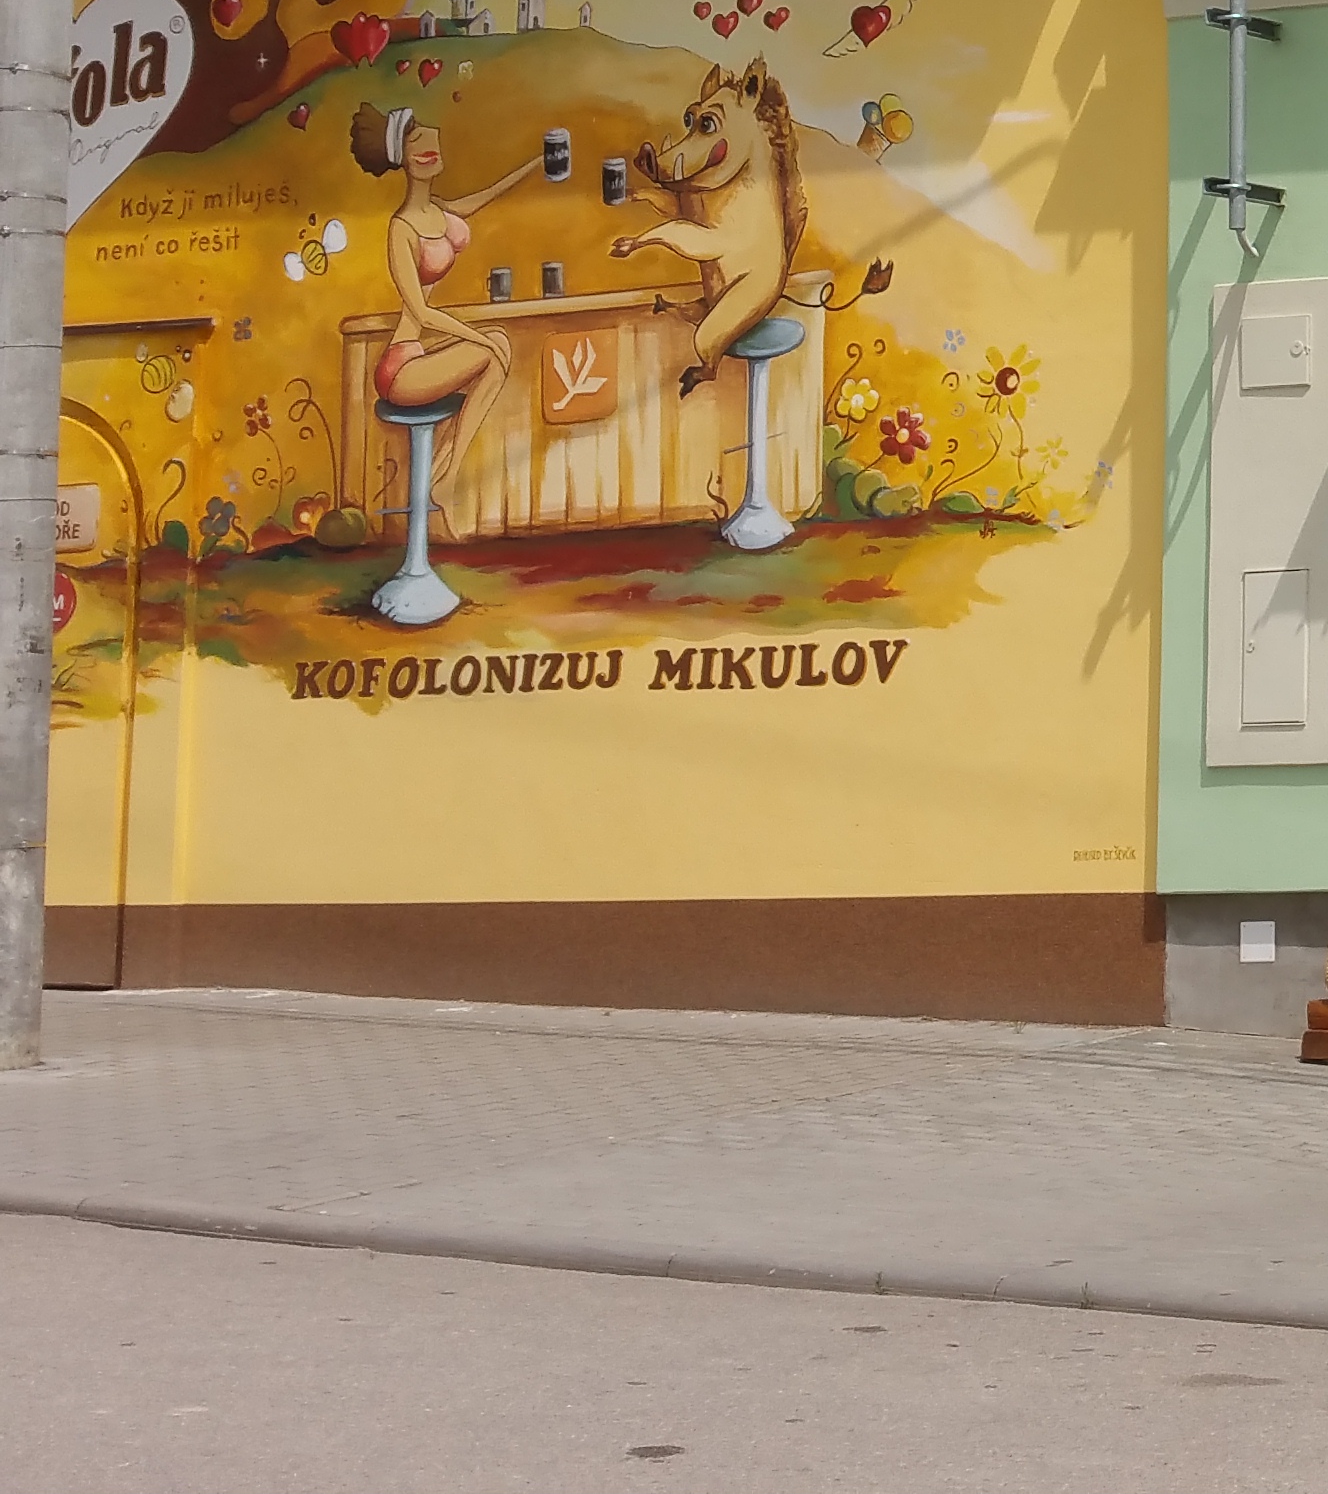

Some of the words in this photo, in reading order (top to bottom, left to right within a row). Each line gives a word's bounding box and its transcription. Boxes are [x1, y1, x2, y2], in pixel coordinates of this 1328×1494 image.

[120, 188, 174, 224] Když
[203, 179, 299, 213] miluješ,
[95, 234, 149, 262] není
[155, 238, 179, 256] co
[189, 226, 240, 253] řešit
[291, 648, 624, 702] KOFOLONIZUJ
[647, 637, 911, 692] MIKULOV
